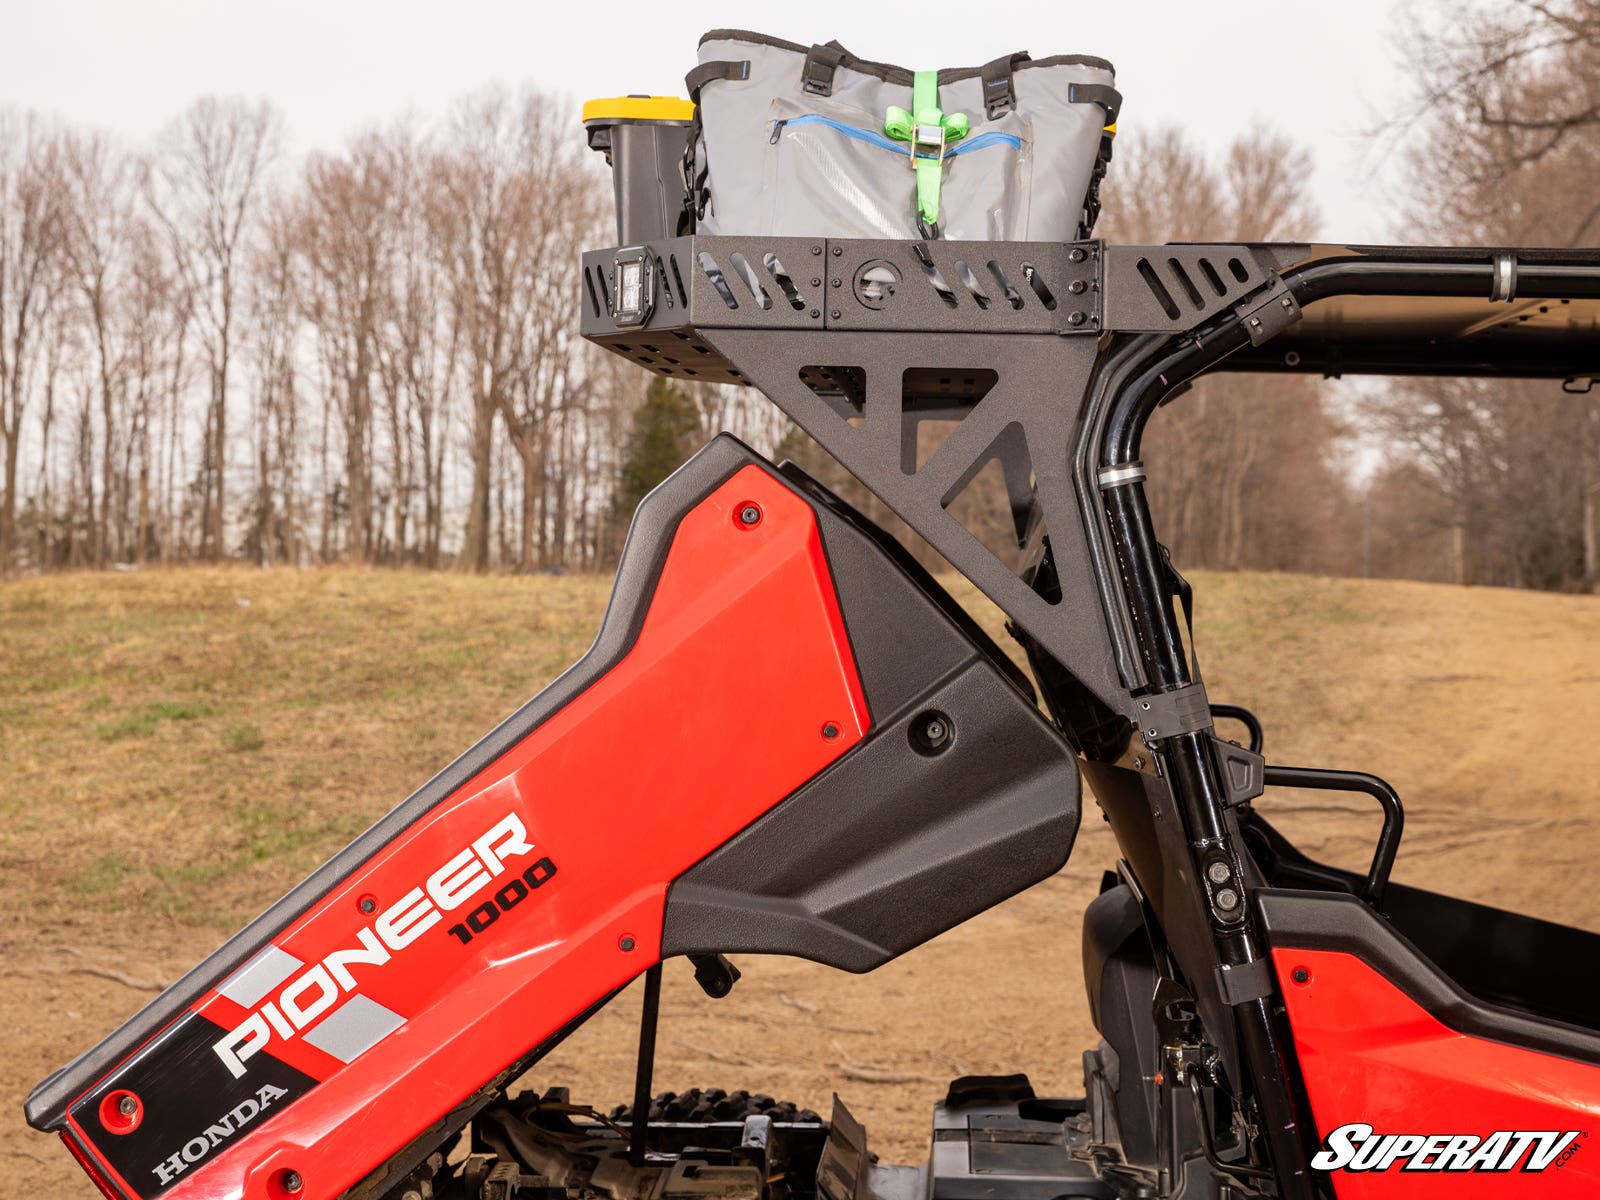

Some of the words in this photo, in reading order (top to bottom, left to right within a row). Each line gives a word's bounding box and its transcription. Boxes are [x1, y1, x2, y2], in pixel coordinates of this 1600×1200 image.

[212, 811, 535, 1079] PIONEER
[447, 857, 558, 945] 1000
[152, 1084, 288, 1186] HONDA
